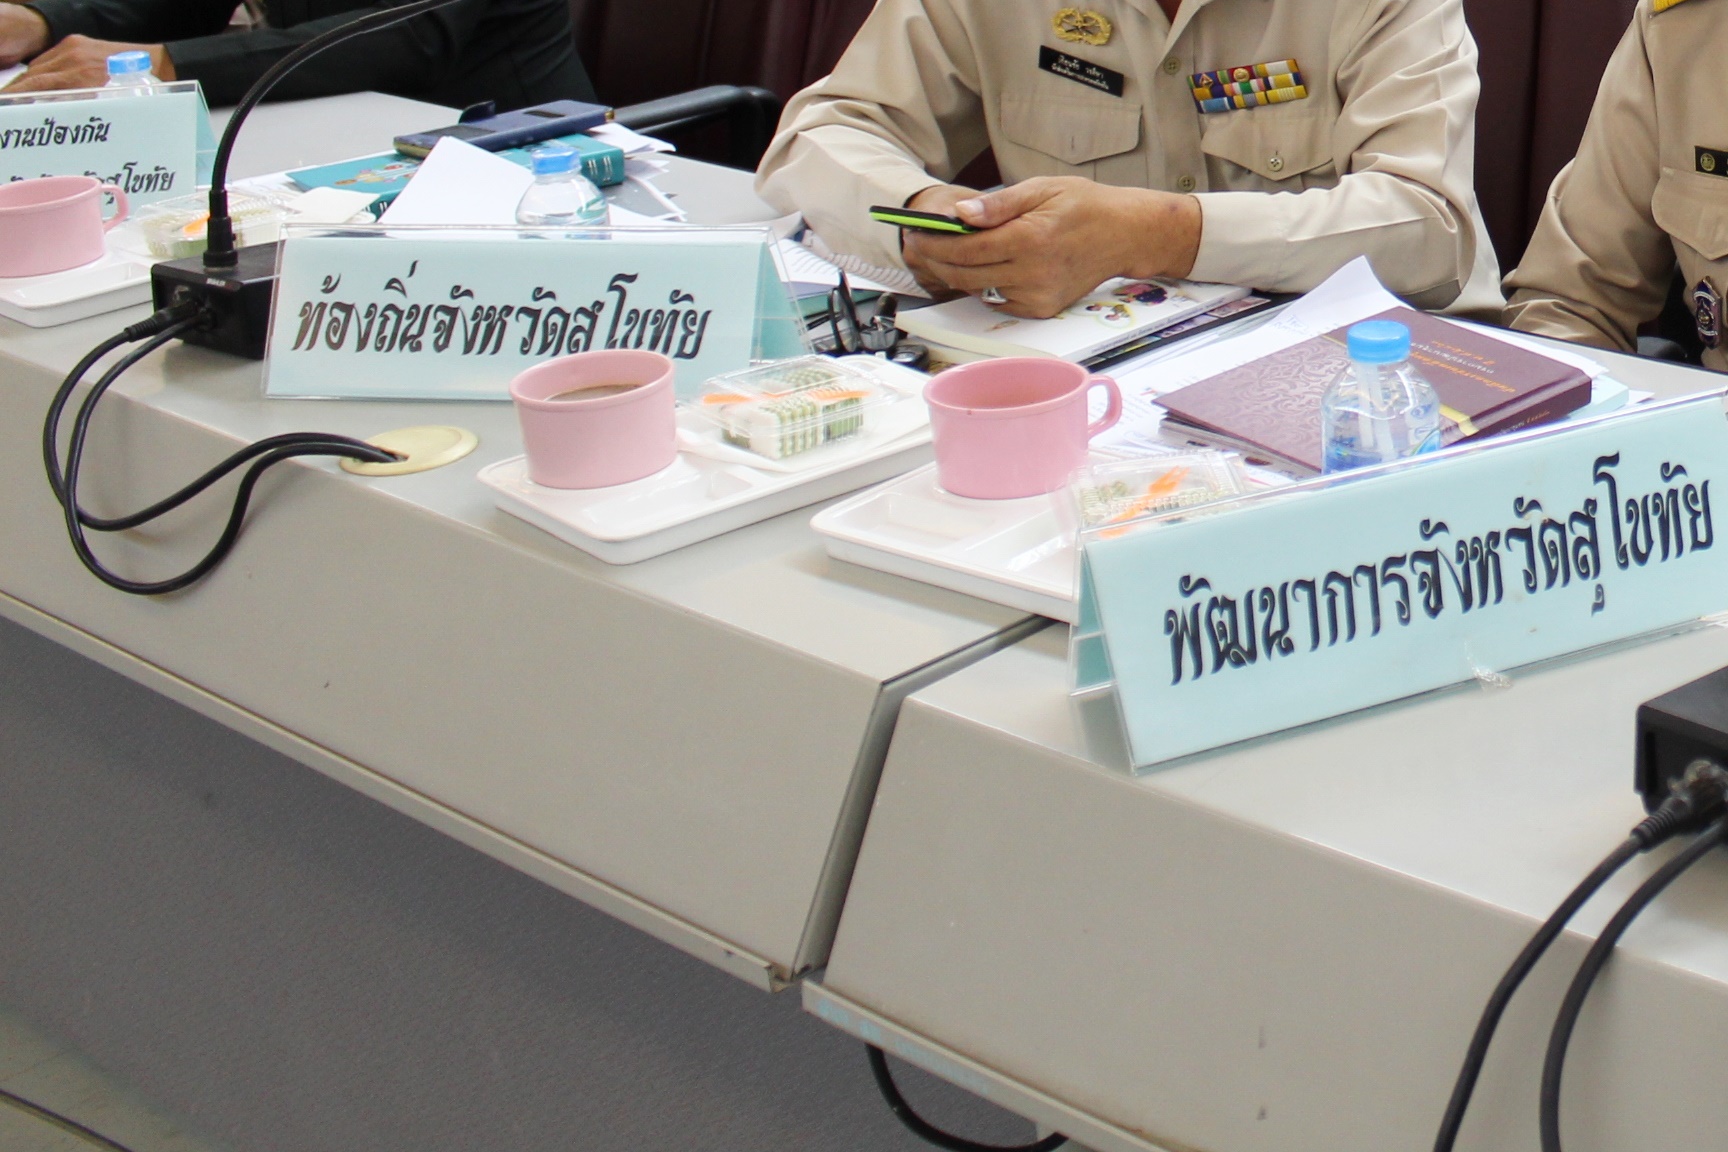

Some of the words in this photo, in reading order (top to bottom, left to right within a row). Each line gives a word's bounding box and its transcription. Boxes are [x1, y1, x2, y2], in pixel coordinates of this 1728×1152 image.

[290, 260, 713, 359] ท้องถิ่นจังหวัดสโขทัย
[1163, 451, 1714, 686] พัฒนาการจังหวัดสุโขทัย
